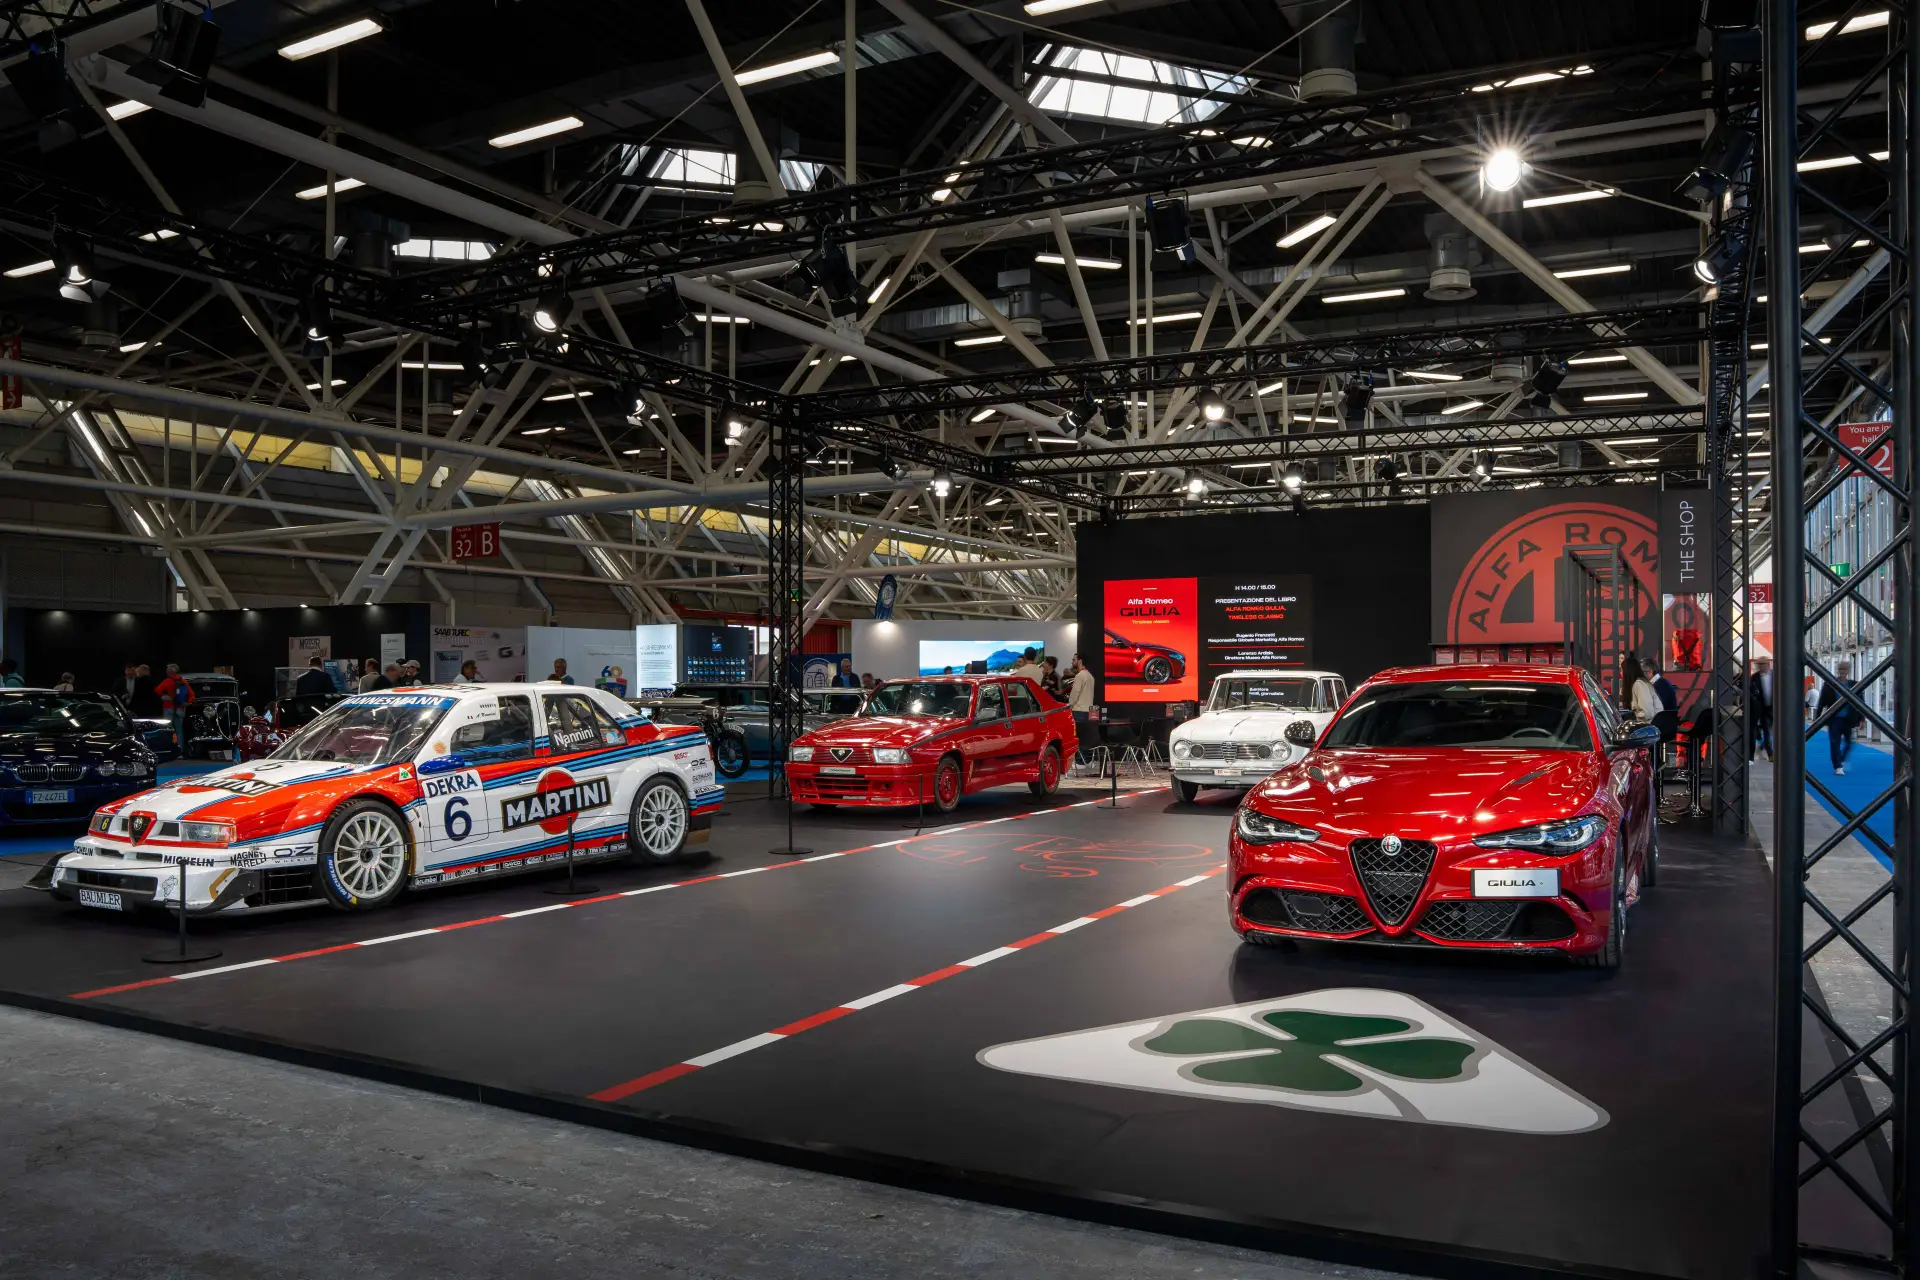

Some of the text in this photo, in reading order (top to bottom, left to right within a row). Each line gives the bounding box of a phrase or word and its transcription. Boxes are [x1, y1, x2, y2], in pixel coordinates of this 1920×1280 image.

[455, 540, 472, 557] 32
[482, 531, 493, 555] B
[1680, 500, 1694, 583] THE SHOP
[1469, 538, 1542, 633] ALFA
[1750, 592, 1765, 602] 32
[1120, 607, 1180, 616] GIULIA
[712, 708, 719, 719] 6
[553, 727, 595, 747] Nannini
[427, 773, 478, 798] DEKRA
[507, 780, 607, 827] MARTINI
[101, 818, 109, 830] 6
[444, 795, 472, 841] 6
[164, 855, 214, 867] MICHELIN
[1488, 879, 1536, 887] GIULIA
[81, 890, 120, 906] BAUMLER
